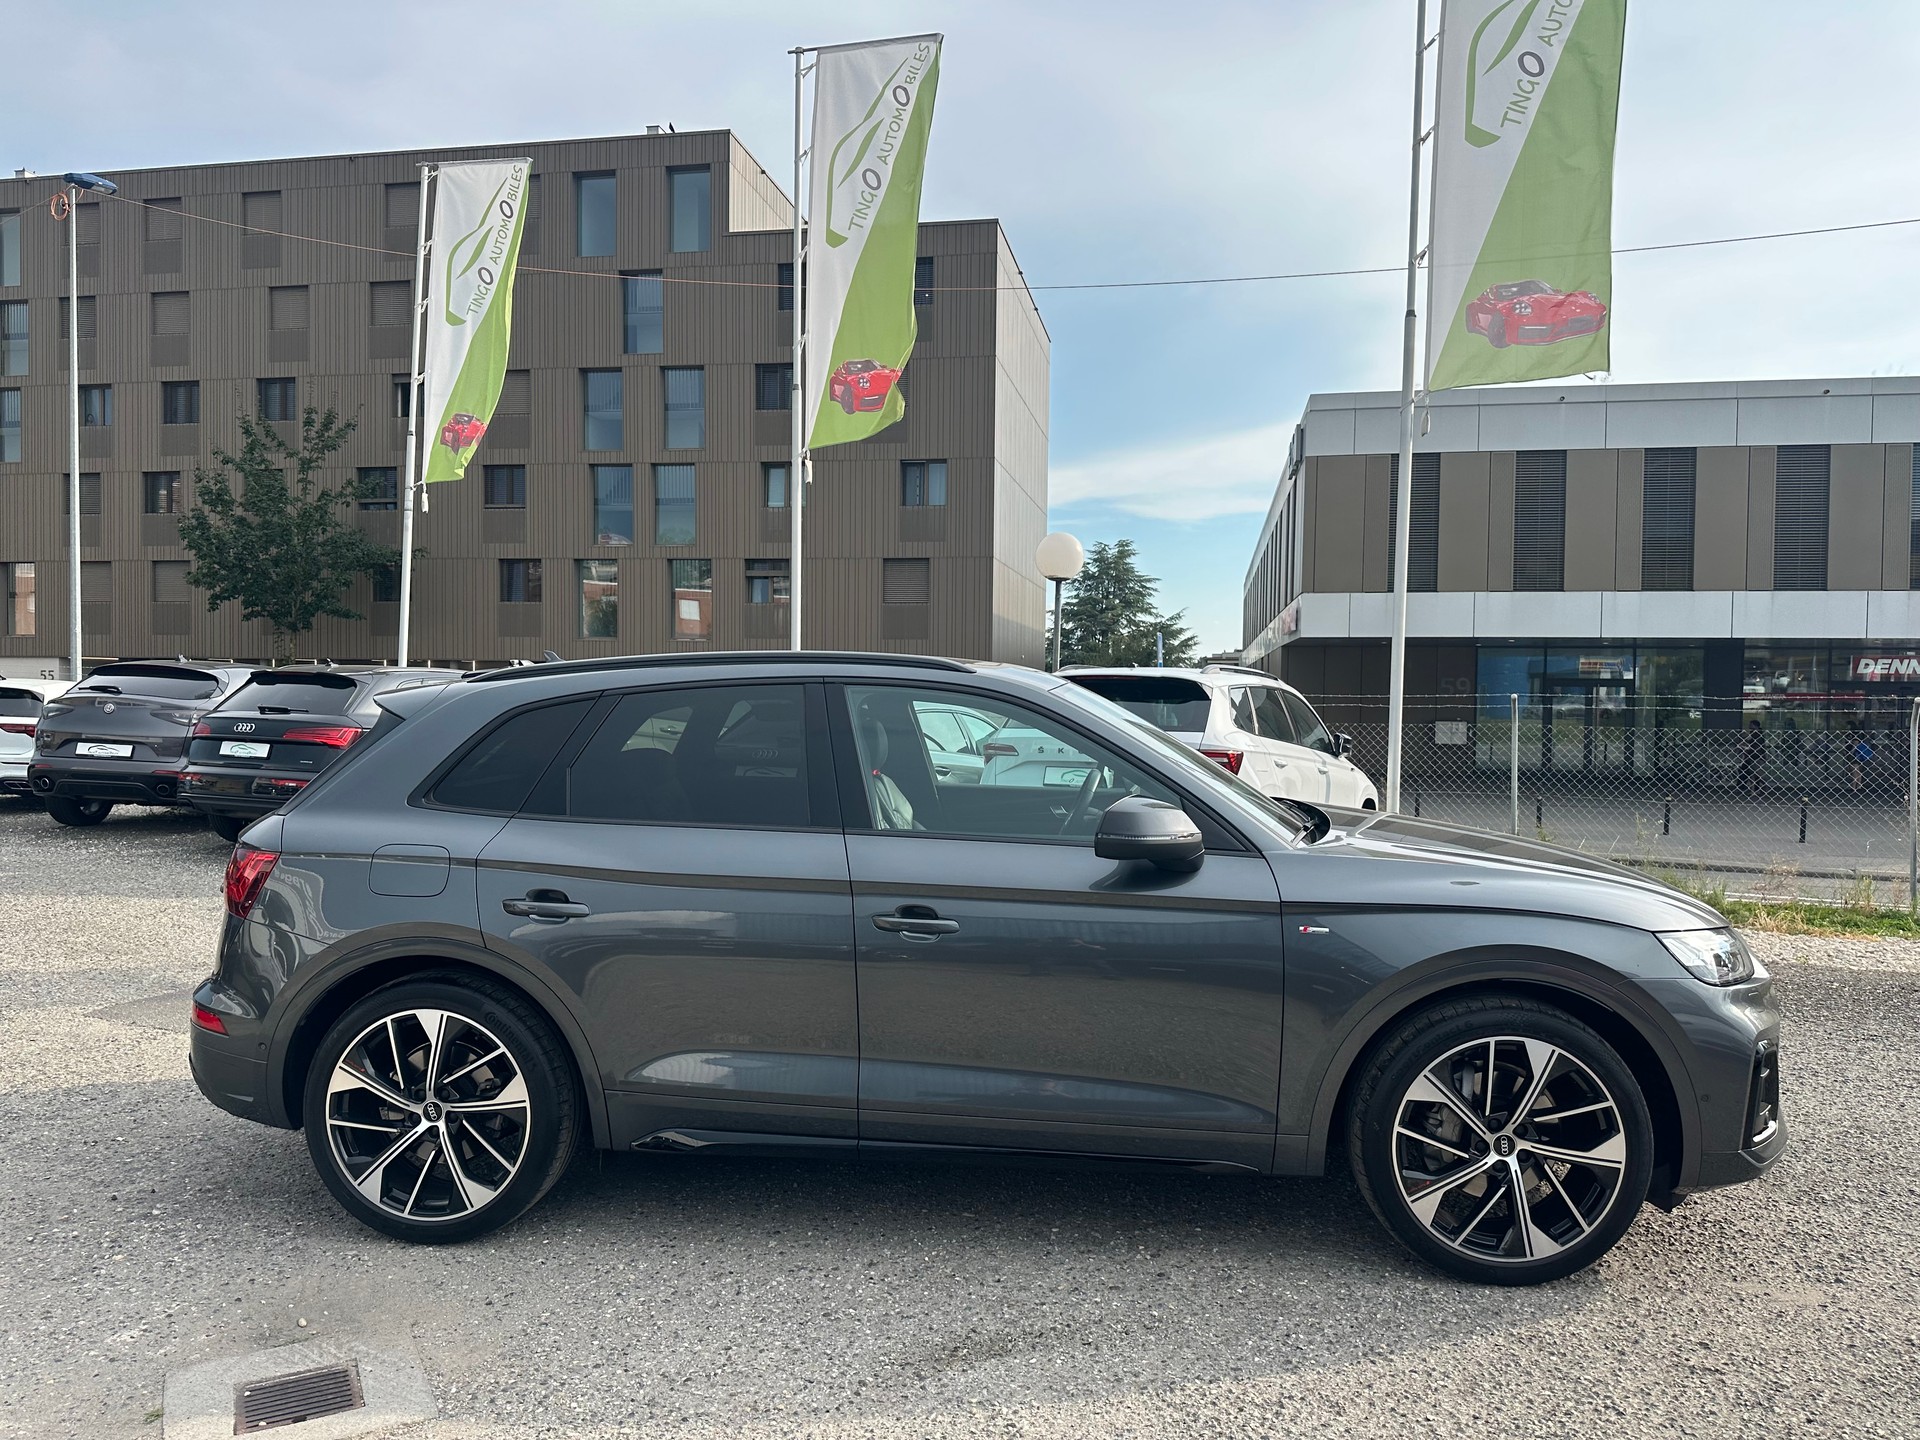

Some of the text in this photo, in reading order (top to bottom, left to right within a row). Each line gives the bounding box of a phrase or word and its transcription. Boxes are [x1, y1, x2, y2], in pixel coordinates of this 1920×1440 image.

[1500, 51, 1545, 128] TINGO
[847, 42, 930, 231] TINGO AUTOMOBILES
[466, 164, 524, 316] TINGO AUTOMOBILES
[40, 669, 54, 680] 55
[1440, 677, 1472, 695] 59
